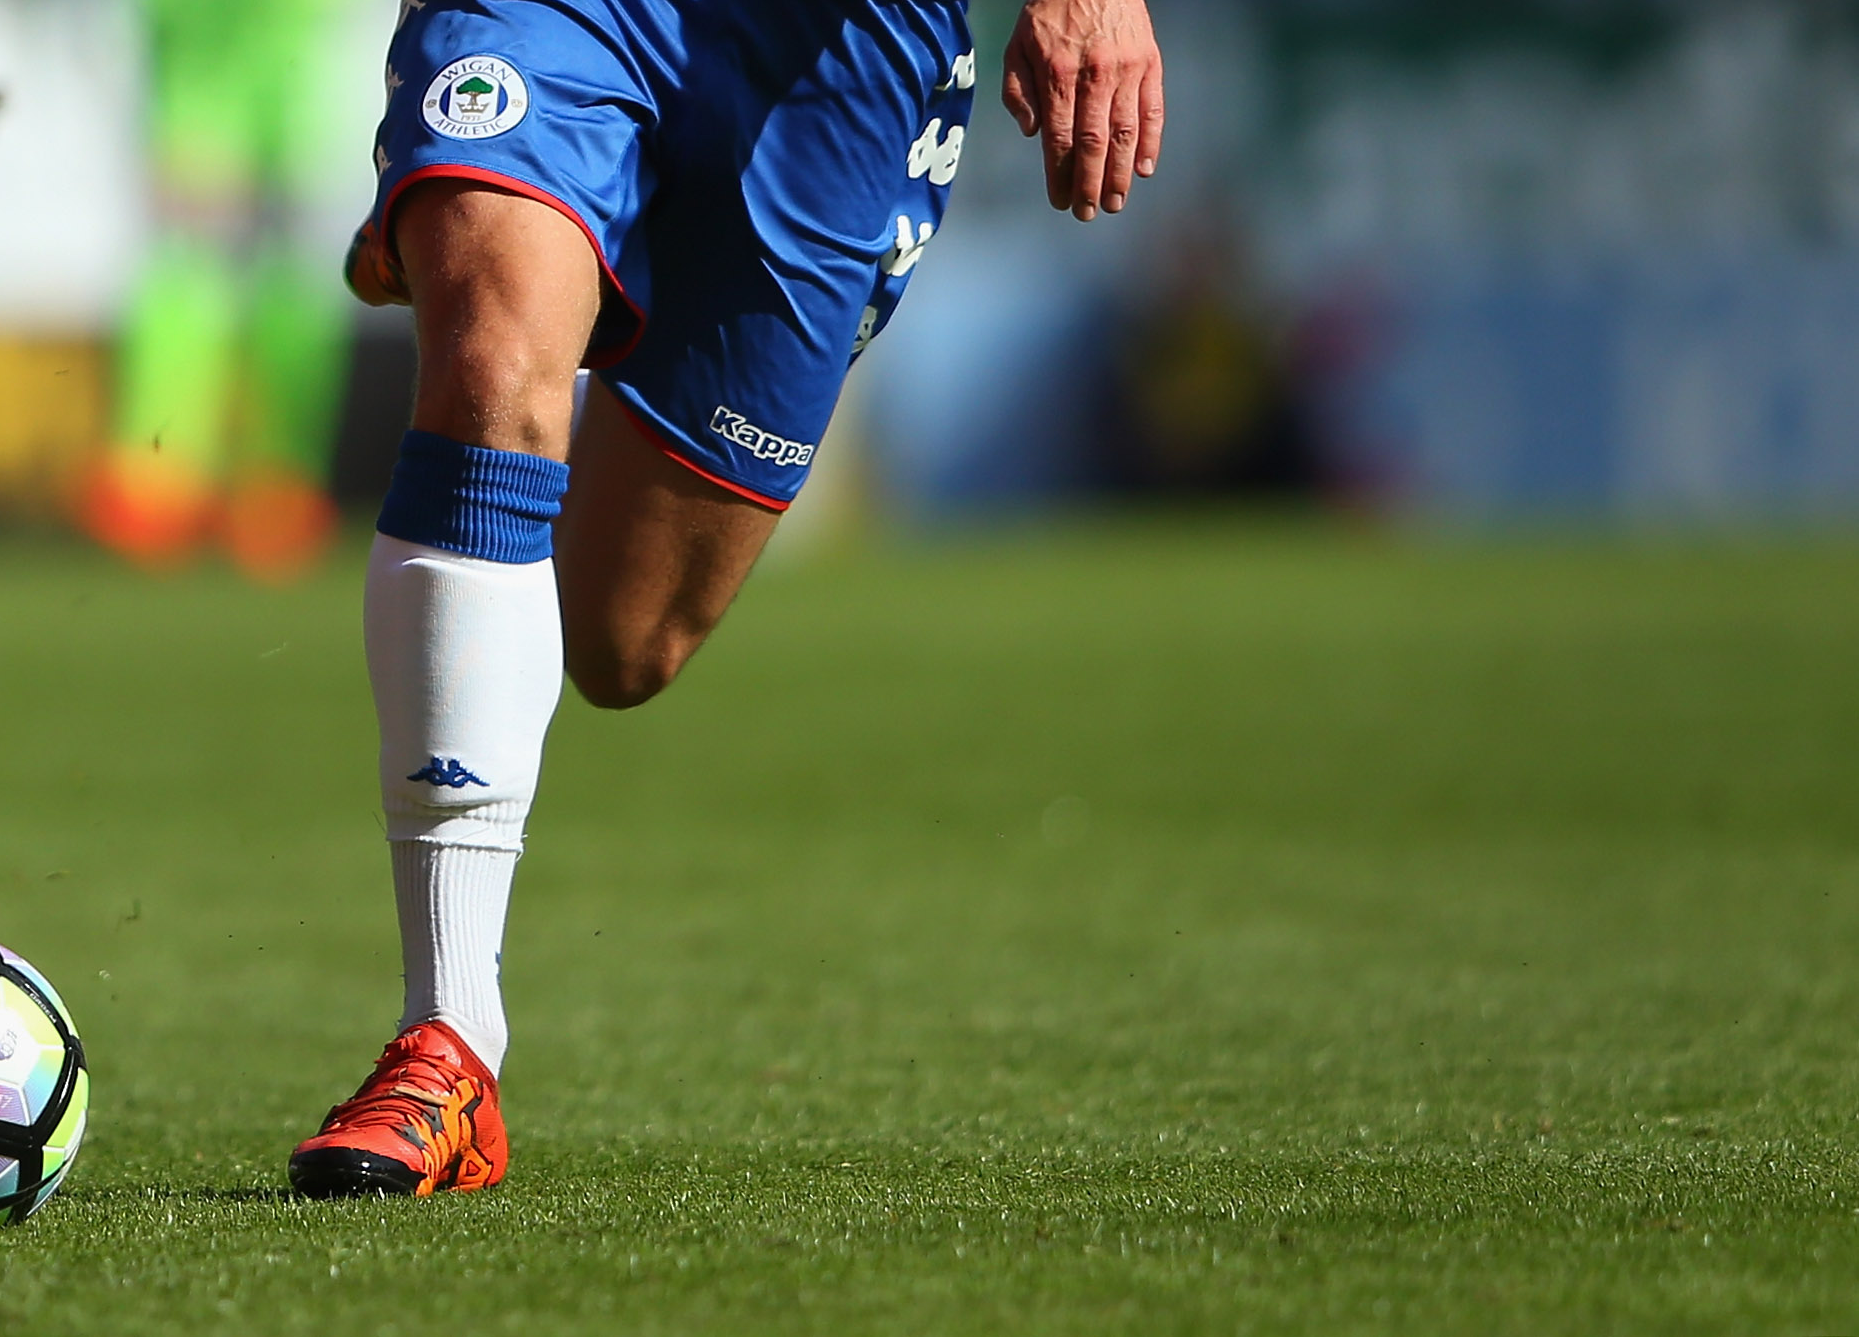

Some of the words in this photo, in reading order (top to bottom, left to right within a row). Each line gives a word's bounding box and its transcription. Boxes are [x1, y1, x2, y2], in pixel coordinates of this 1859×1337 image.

[441, 60, 513, 81] WIGAN
[433, 118, 509, 136] ATHLETIC
[709, 405, 815, 466] Kappa
